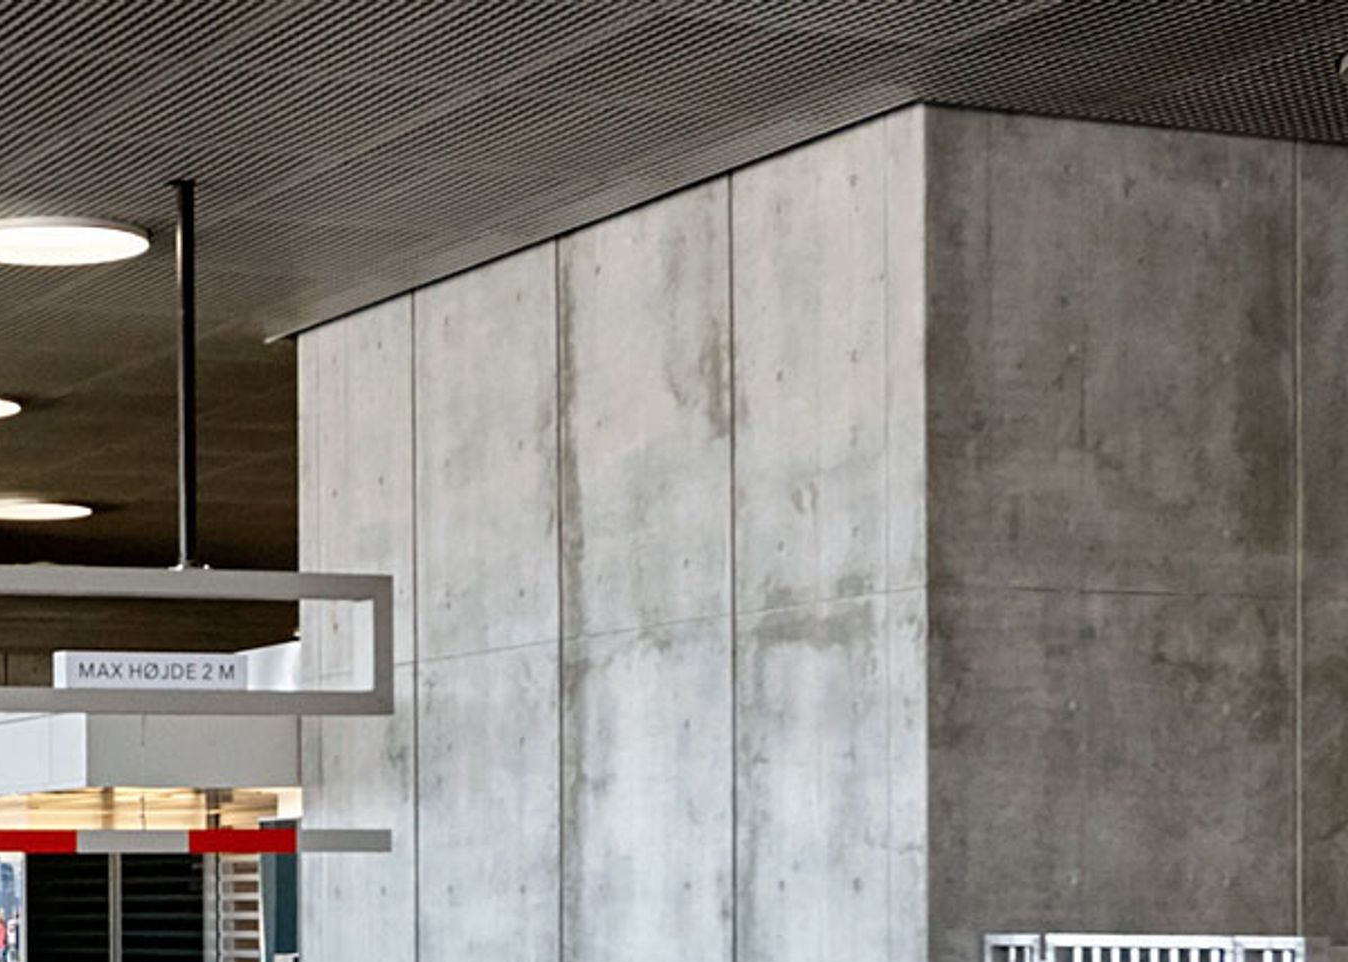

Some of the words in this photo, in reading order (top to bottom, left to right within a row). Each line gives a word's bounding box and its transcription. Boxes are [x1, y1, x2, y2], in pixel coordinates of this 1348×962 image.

[78, 662, 123, 679] MAX
[129, 663, 197, 680] HØJDE
[202, 663, 213, 680] 2
[219, 664, 235, 680] M
